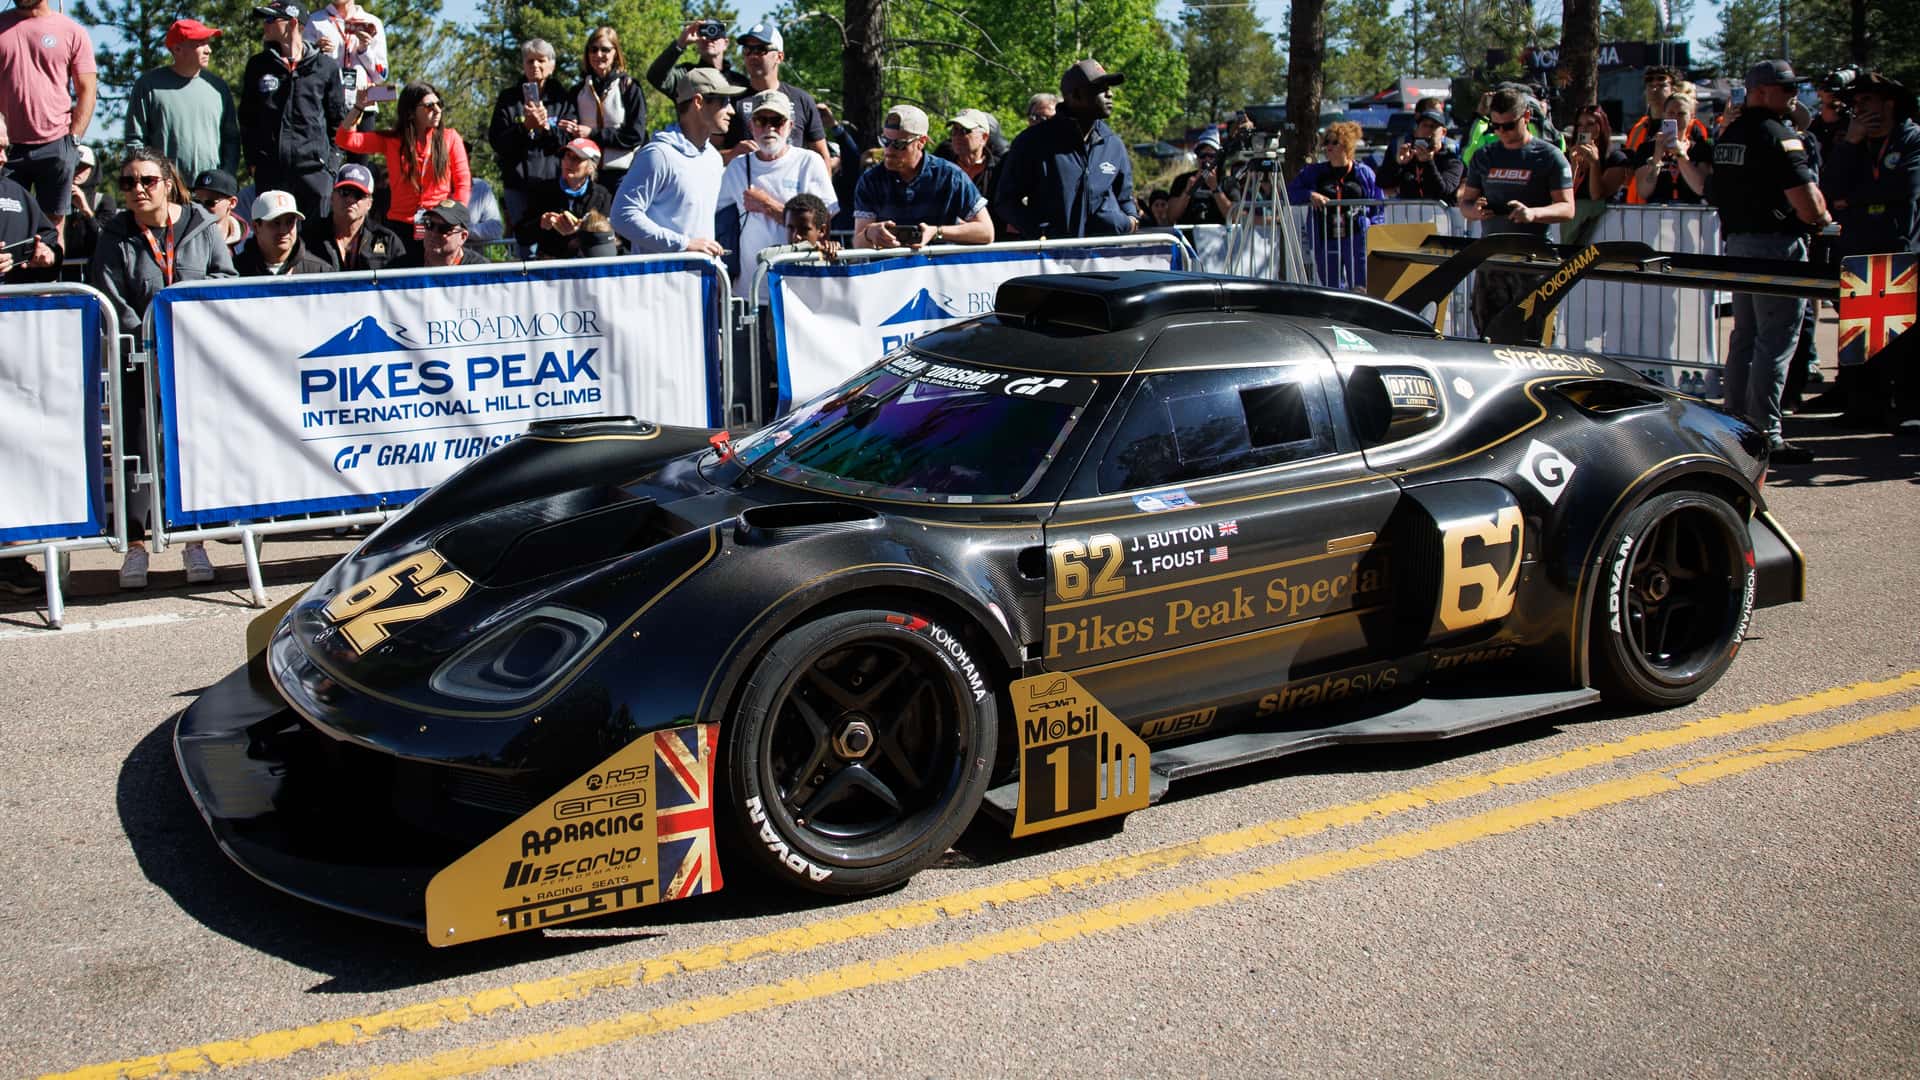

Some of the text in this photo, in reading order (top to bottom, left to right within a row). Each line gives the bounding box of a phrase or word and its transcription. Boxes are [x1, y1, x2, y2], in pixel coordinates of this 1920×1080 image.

[1488, 168, 1532, 179] JUBU
[1536, 244, 1599, 301] YOKOHAMA
[427, 310, 599, 345] BROADMOOR
[458, 308, 480, 319] THE
[301, 348, 600, 404] PIKES PEAK
[1494, 348, 1604, 375] stratasys
[929, 379, 980, 391] SIMULATOR
[1390, 378, 1435, 396] OPTIMA
[302, 387, 602, 428] INTERNATIONAL HILL CLIMB
[377, 437, 437, 466] GRAN
[443, 433, 521, 460] TURIS
[1531, 452, 1565, 488] G
[1131, 524, 1214, 552] J. BUTTON
[1051, 534, 1126, 601] 62
[1132, 549, 1204, 576] T. FOUST
[1438, 506, 1524, 632] 62
[321, 548, 474, 656] 62
[1609, 535, 1634, 633] ADVAN
[1045, 556, 1391, 659] Pikes Peak Special
[1733, 568, 1756, 644] YOKOHAMA
[929, 623, 986, 702] YOKOHAMA
[1256, 667, 1399, 717] stratasys
[1025, 705, 1098, 745] Mobil
[1142, 710, 1214, 738] JUBU
[605, 765, 650, 785] R53
[1046, 746, 1069, 813] 1
[559, 792, 642, 816] aria
[746, 796, 833, 882] ADVAN
[545, 846, 641, 881] scarbo
[497, 879, 654, 929] TILLETT
[537, 876, 629, 901] RACING SEATS
